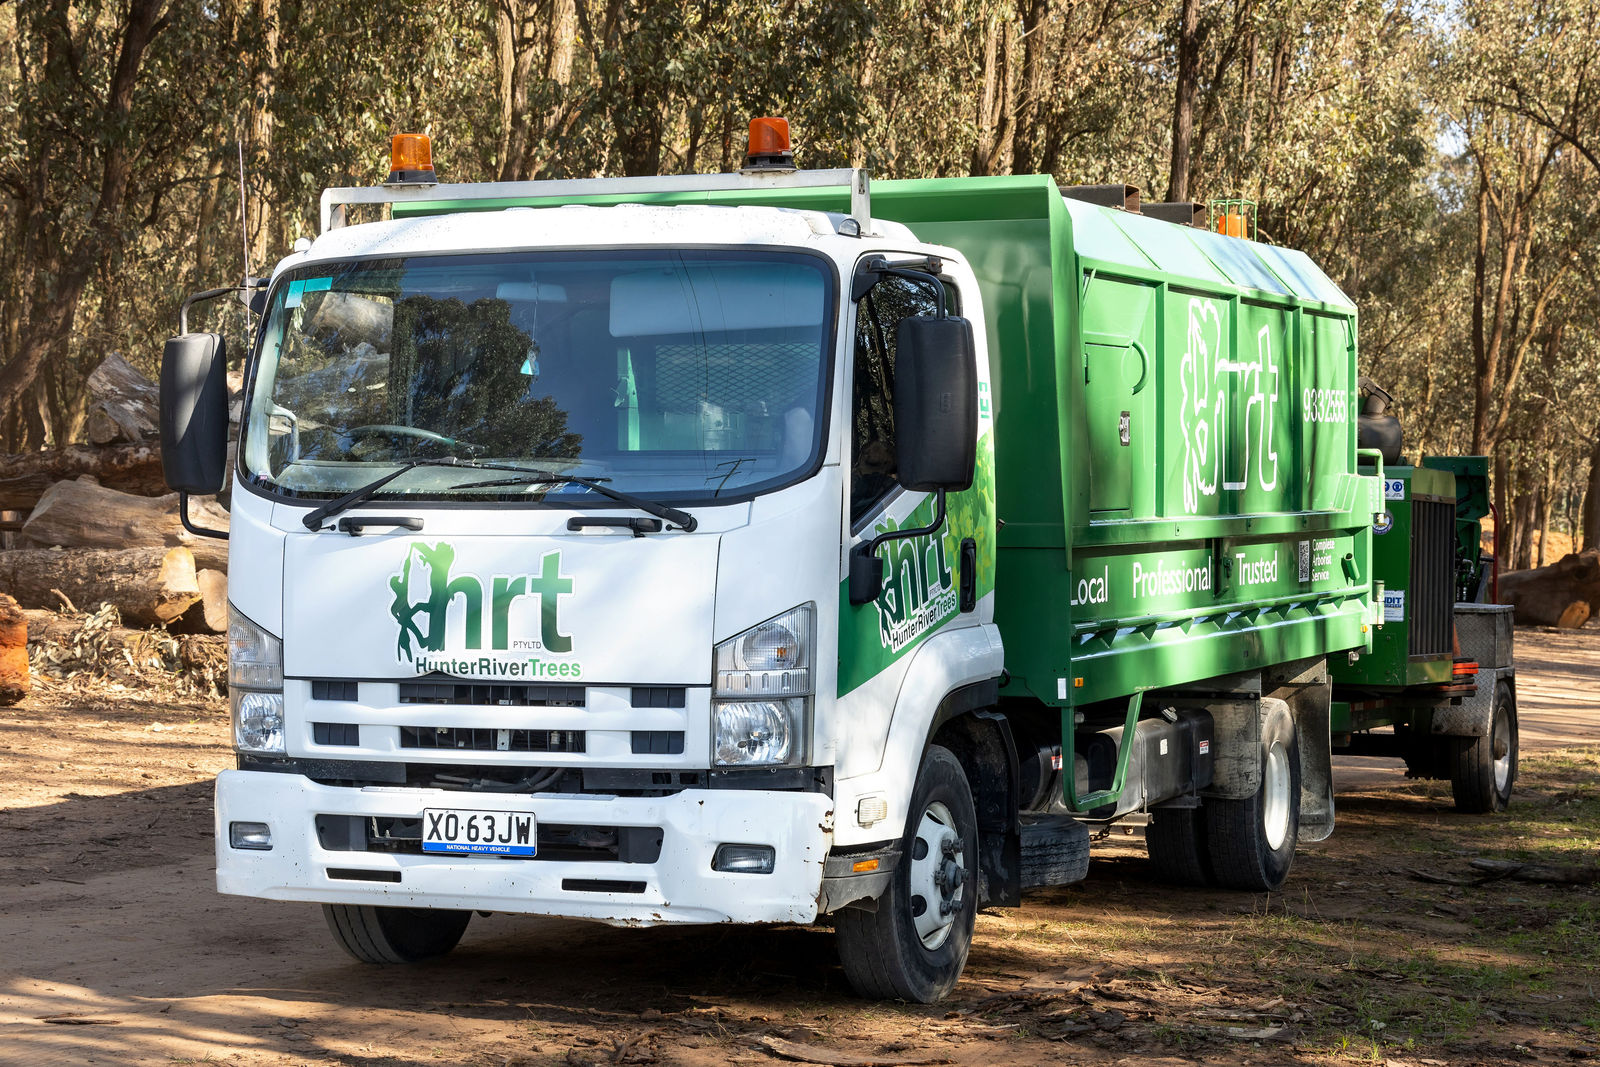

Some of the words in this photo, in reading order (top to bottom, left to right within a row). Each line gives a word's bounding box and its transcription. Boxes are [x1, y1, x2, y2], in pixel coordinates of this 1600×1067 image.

[423, 542, 573, 653] hrt
[1132, 555, 1212, 599] Professional
[1235, 550, 1278, 586] Trusted
